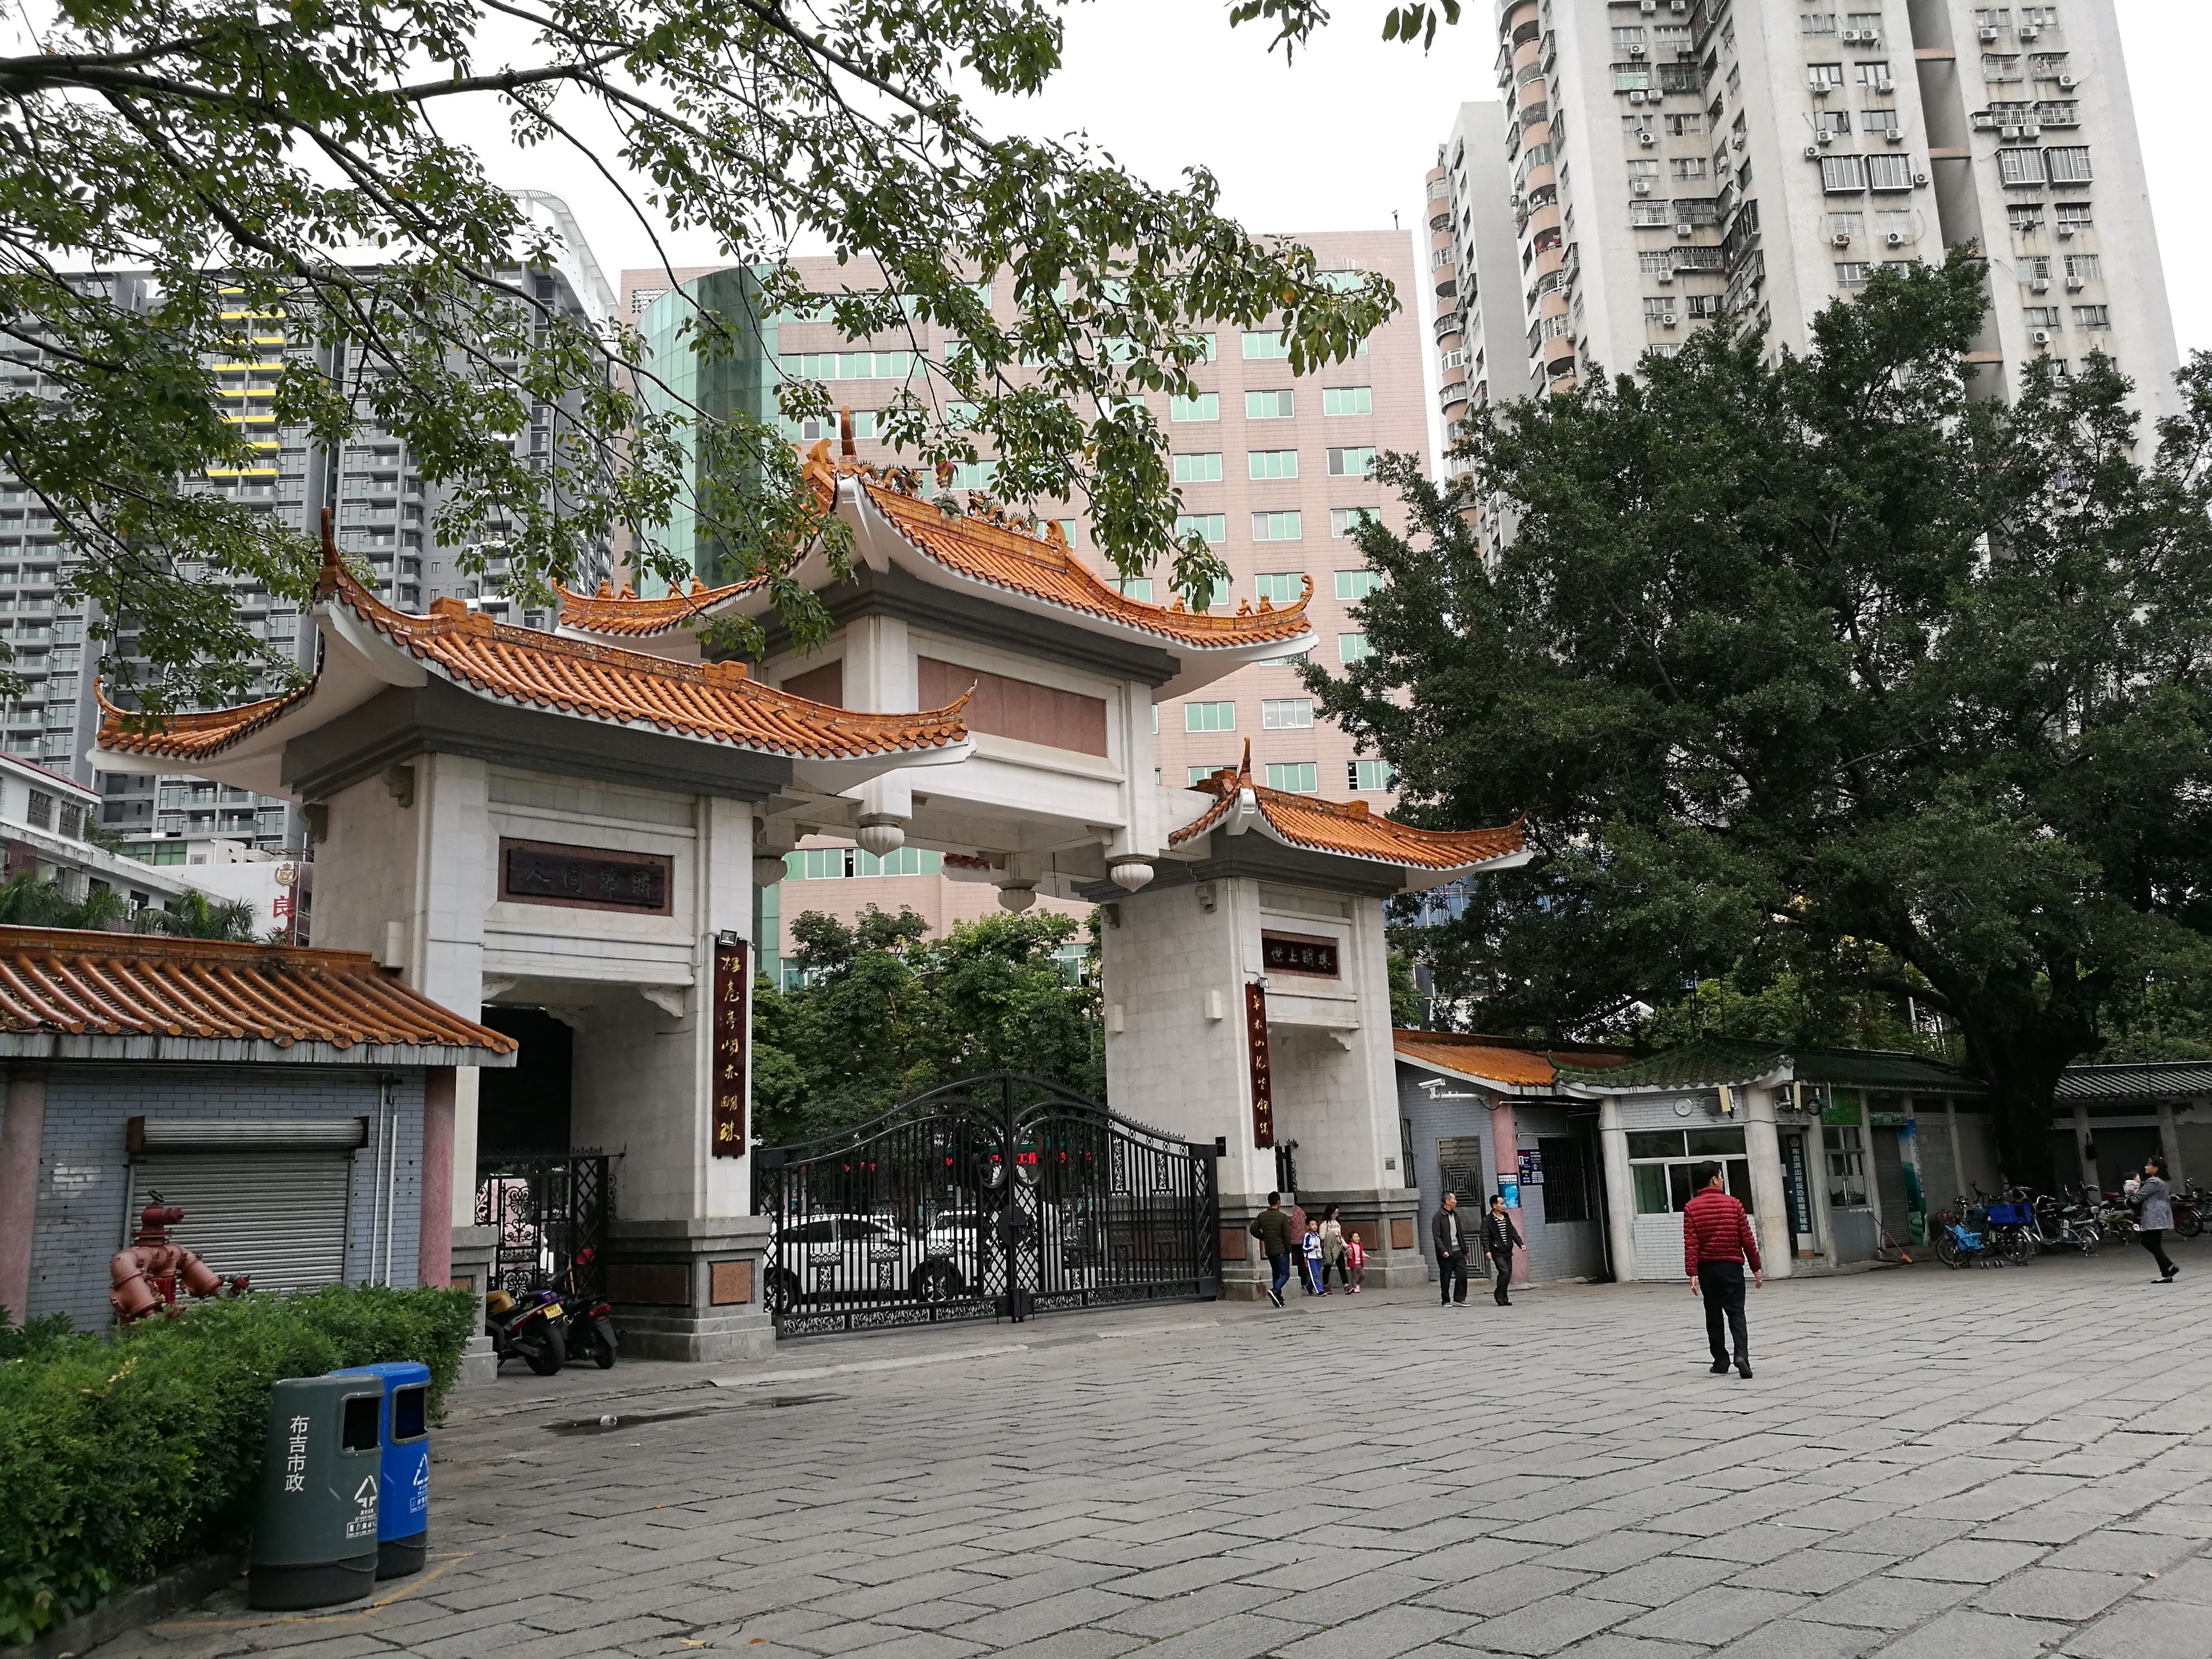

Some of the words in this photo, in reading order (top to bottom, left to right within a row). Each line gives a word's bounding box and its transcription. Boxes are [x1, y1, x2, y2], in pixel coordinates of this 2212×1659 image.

[1271, 946, 1331, 969] 世上明珠
[285, 1415, 310, 1492] 布吉市政
